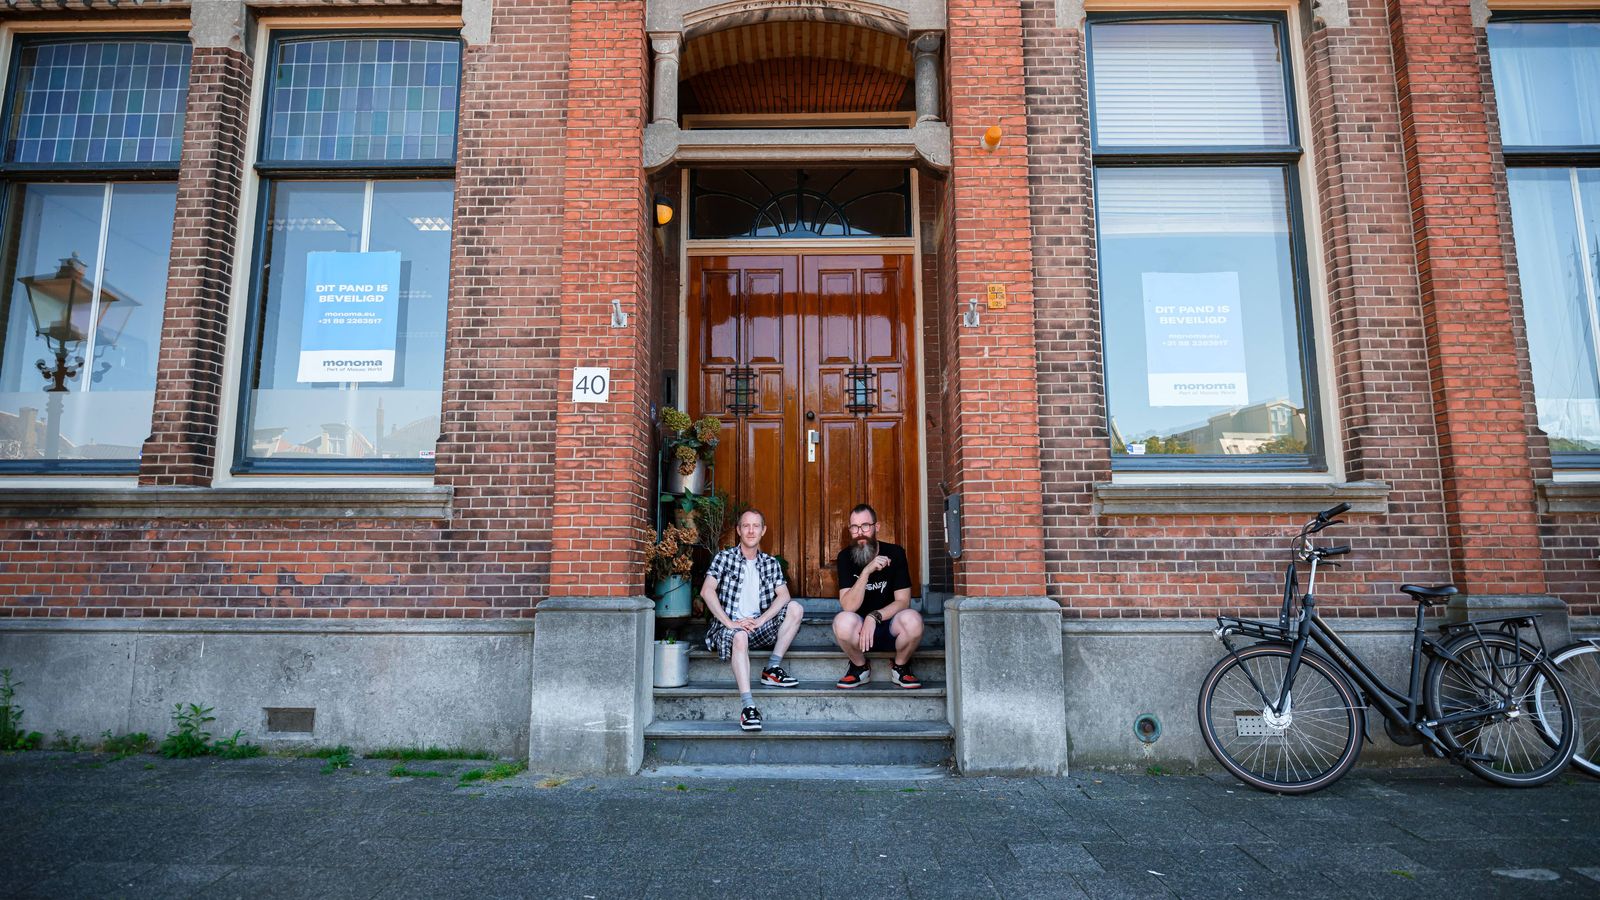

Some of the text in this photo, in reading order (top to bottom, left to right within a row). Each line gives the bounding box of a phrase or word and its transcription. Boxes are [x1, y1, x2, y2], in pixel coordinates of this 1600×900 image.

[316, 284, 388, 292] DIT PAND IS
[319, 294, 385, 303] BEVEILIGD
[1155, 305, 1231, 314] DIT PAND IS
[1160, 316, 1227, 325] BEVEILIGD
[323, 359, 383, 367] monoma
[576, 375, 606, 395] 40
